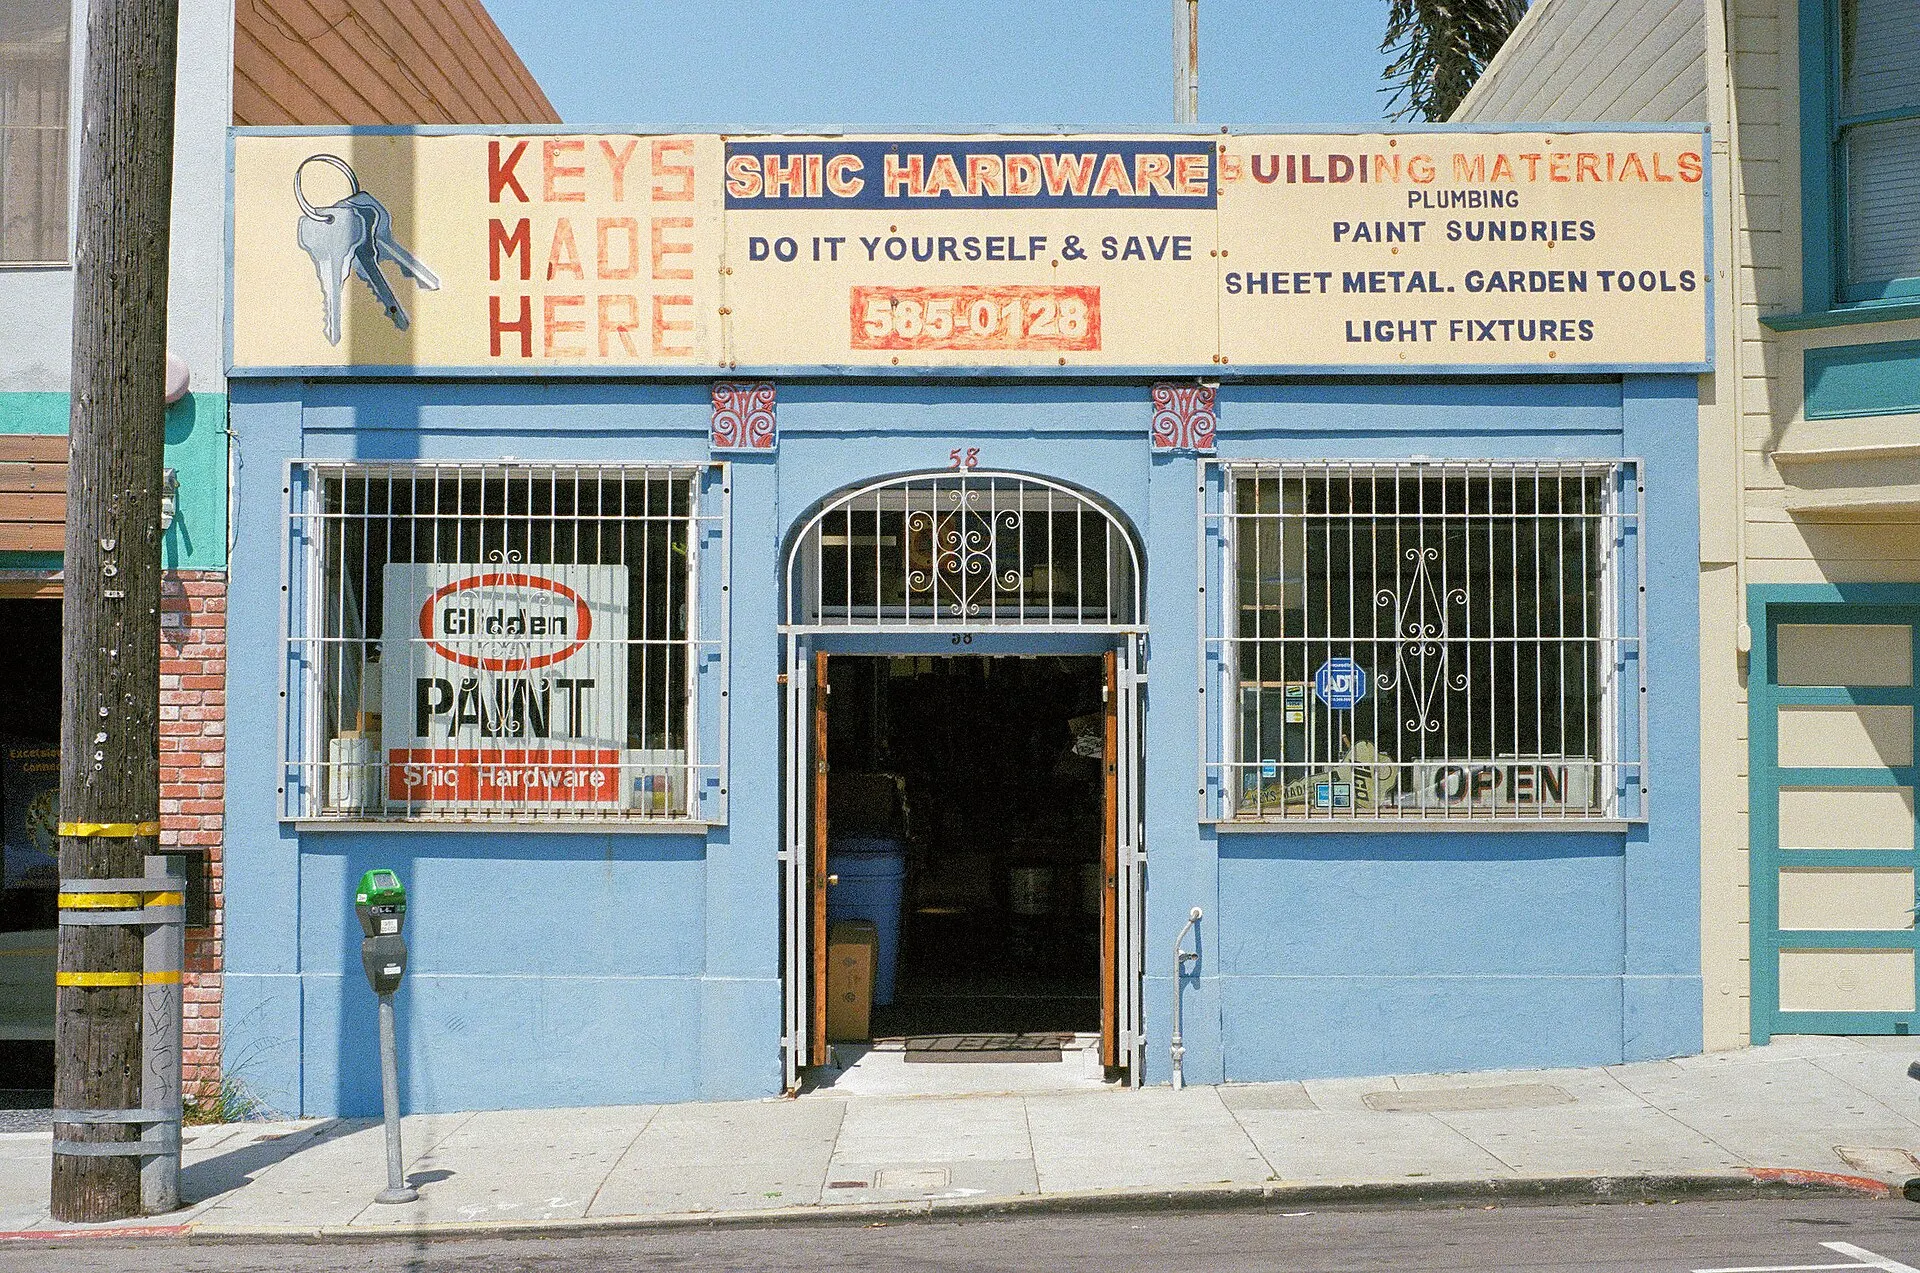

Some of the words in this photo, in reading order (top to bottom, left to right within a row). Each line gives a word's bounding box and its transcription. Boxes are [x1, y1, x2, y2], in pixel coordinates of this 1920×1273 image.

[488, 140, 695, 203] KEYS
[726, 154, 864, 199] SHIC
[884, 153, 1209, 198] HARDWARE
[1219, 154, 1435, 184] BUILDING
[1452, 152, 1703, 184] MATERIALS
[1408, 190, 1519, 209] PLUMBING
[1333, 221, 1426, 243] PAINT
[1446, 220, 1596, 242] SUNDRIES
[489, 217, 694, 281] MADE
[749, 237, 798, 261] DO
[813, 237, 846, 261] IT
[860, 236, 1047, 261] YOURSELF
[1061, 235, 1088, 261] &
[1101, 235, 1193, 261] SAVE
[1226, 272, 1332, 295] SHEET
[1465, 269, 1587, 293] GARDEN
[1597, 269, 1696, 293] TOOLS
[489, 294, 695, 358] HERE
[864, 296, 1088, 339] 585-0128
[1345, 320, 1437, 342] LIGHT
[1449, 319, 1594, 342] FIXTURES
[949, 447, 981, 468] 58
[443, 608, 567, 635] Gldden
[416, 678, 595, 738] PAINT
[403, 765, 459, 786] Shic
[479, 765, 605, 787] Hardware
[1434, 764, 1569, 804] OPEN
